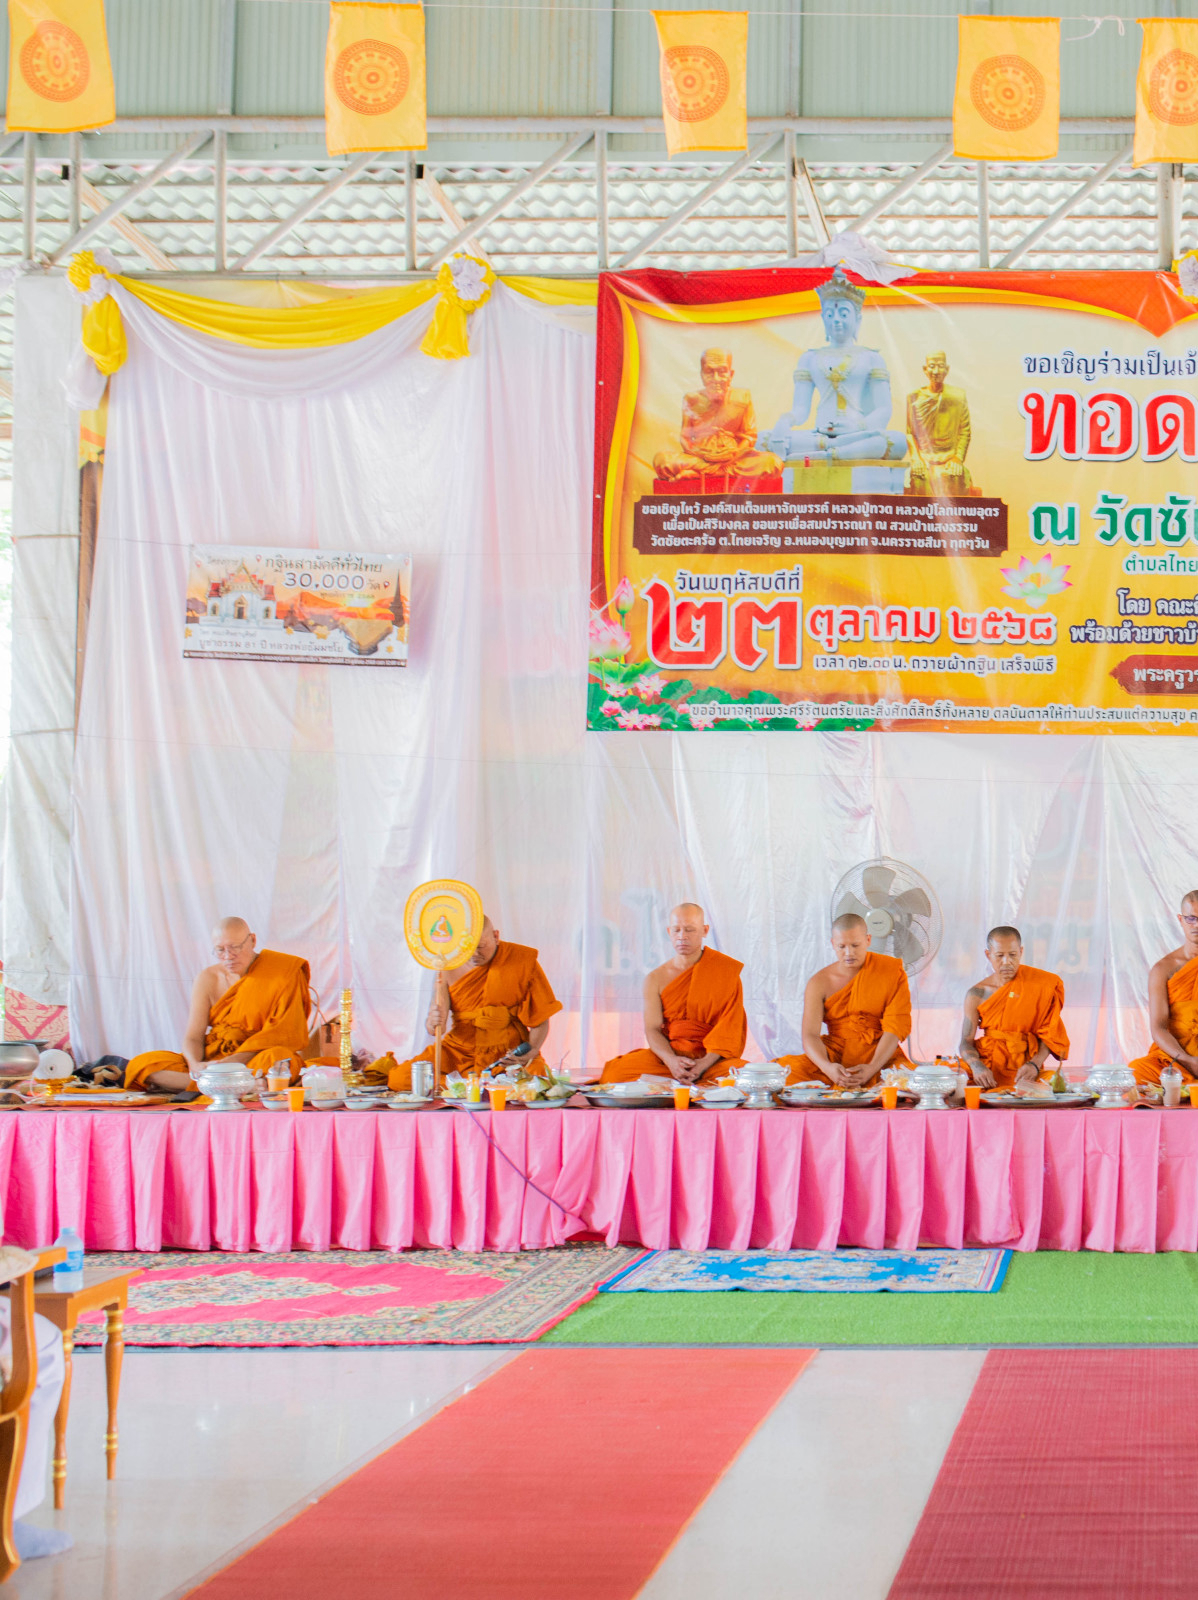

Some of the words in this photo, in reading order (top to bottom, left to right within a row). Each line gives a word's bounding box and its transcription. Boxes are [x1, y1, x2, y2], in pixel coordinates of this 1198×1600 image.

[642, 501, 700, 516] ขอเชิญไหว้
[832, 502, 893, 517] หลวงปู่ทวด
[875, 520, 887, 530] ณ
[1032, 506, 1076, 541] ณ
[719, 533, 781, 547] ต.ไทยเจริญ
[784, 536, 868, 549] อ.หนองบุญมาก
[871, 536, 946, 549] จ.นครราชสีมา
[676, 566, 801, 594] วันพฤหัสบดีที่
[1117, 589, 1149, 615] โดย
[645, 582, 800, 666] ๒๓
[809, 608, 937, 648] ตุลาคม
[951, 610, 1053, 641] ๒๕๖๘
[814, 657, 846, 669] เวลา
[911, 655, 997, 674] ถวายผ้ากฐิน
[1001, 656, 1054, 672] เสร็จพิธี
